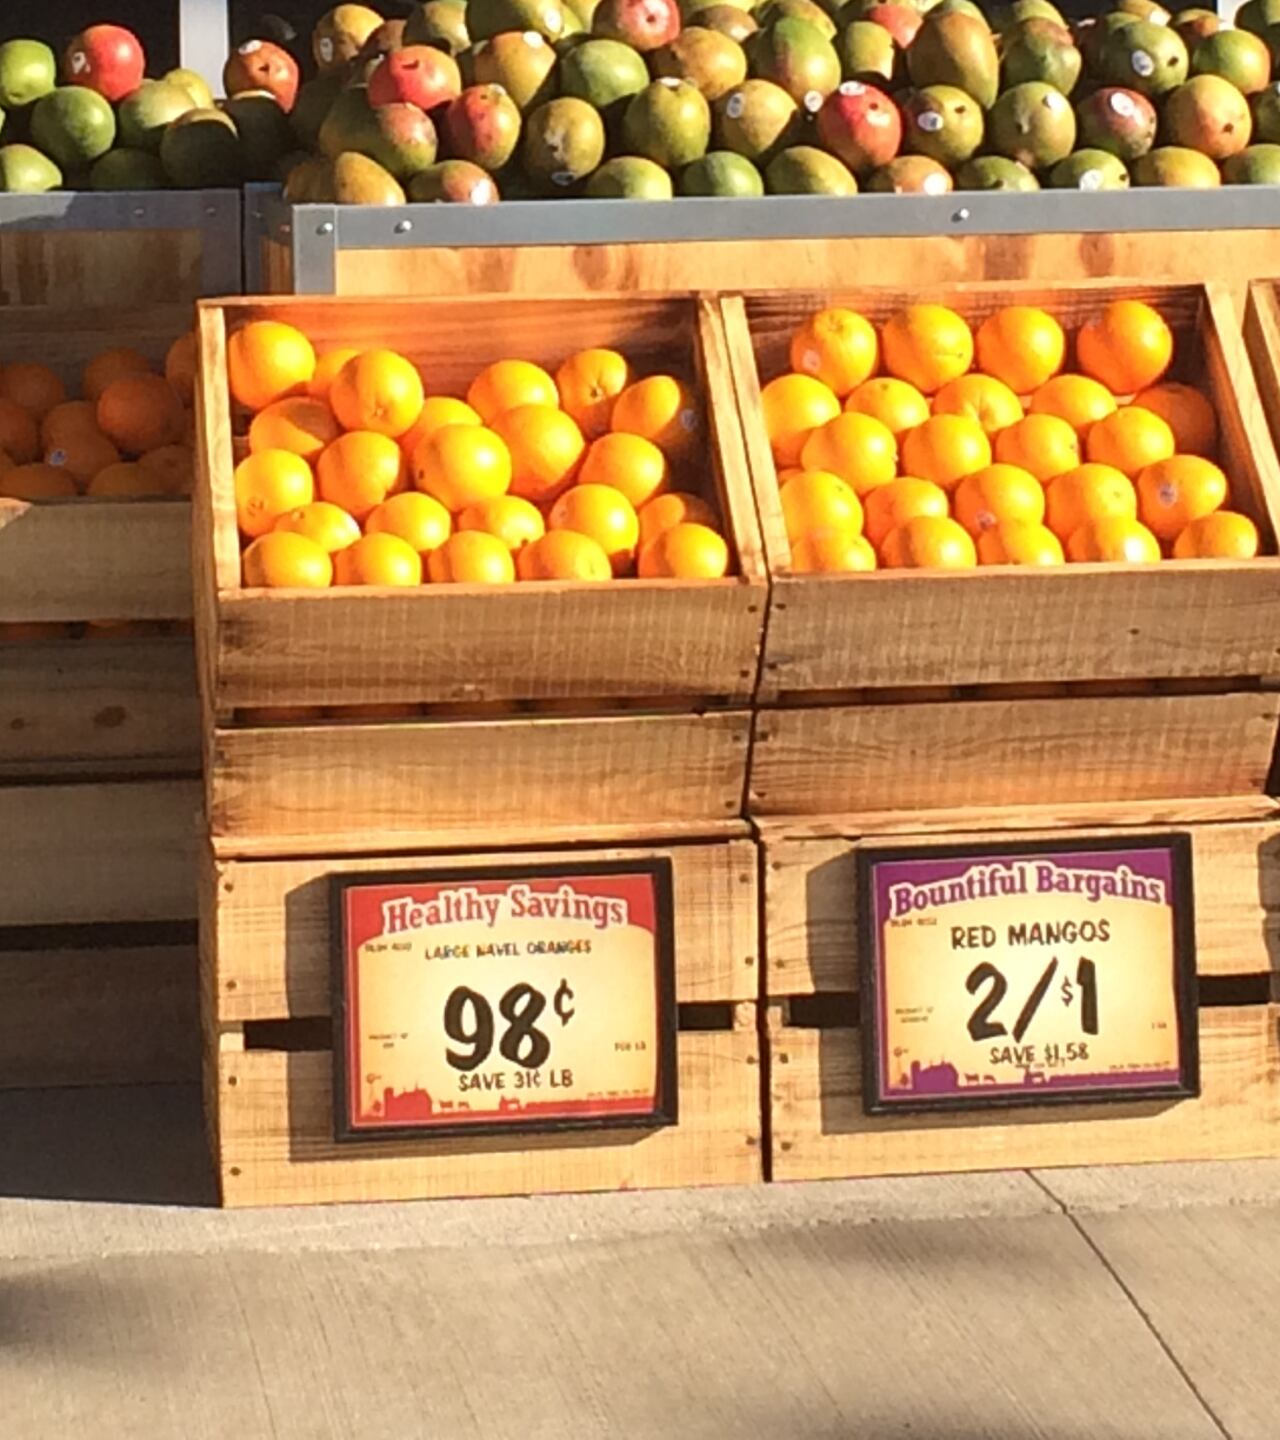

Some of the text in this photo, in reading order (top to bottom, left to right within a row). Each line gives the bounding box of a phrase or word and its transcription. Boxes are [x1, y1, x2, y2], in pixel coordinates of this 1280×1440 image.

[386, 887, 624, 934] Healthy Savings
[893, 865, 1162, 917] Bountiful Bargains
[425, 944, 470, 960] LARGE
[476, 943, 519, 958] NAVEL
[527, 939, 592, 954] ORANGES
[951, 919, 1111, 950] RED MANGOS
[965, 956, 1099, 1043] 2/$1
[443, 978, 576, 1072] 98¢
[989, 1042, 1090, 1065] SAVE $1.58
[458, 1070, 574, 1092] SAVE 31¢ LB
